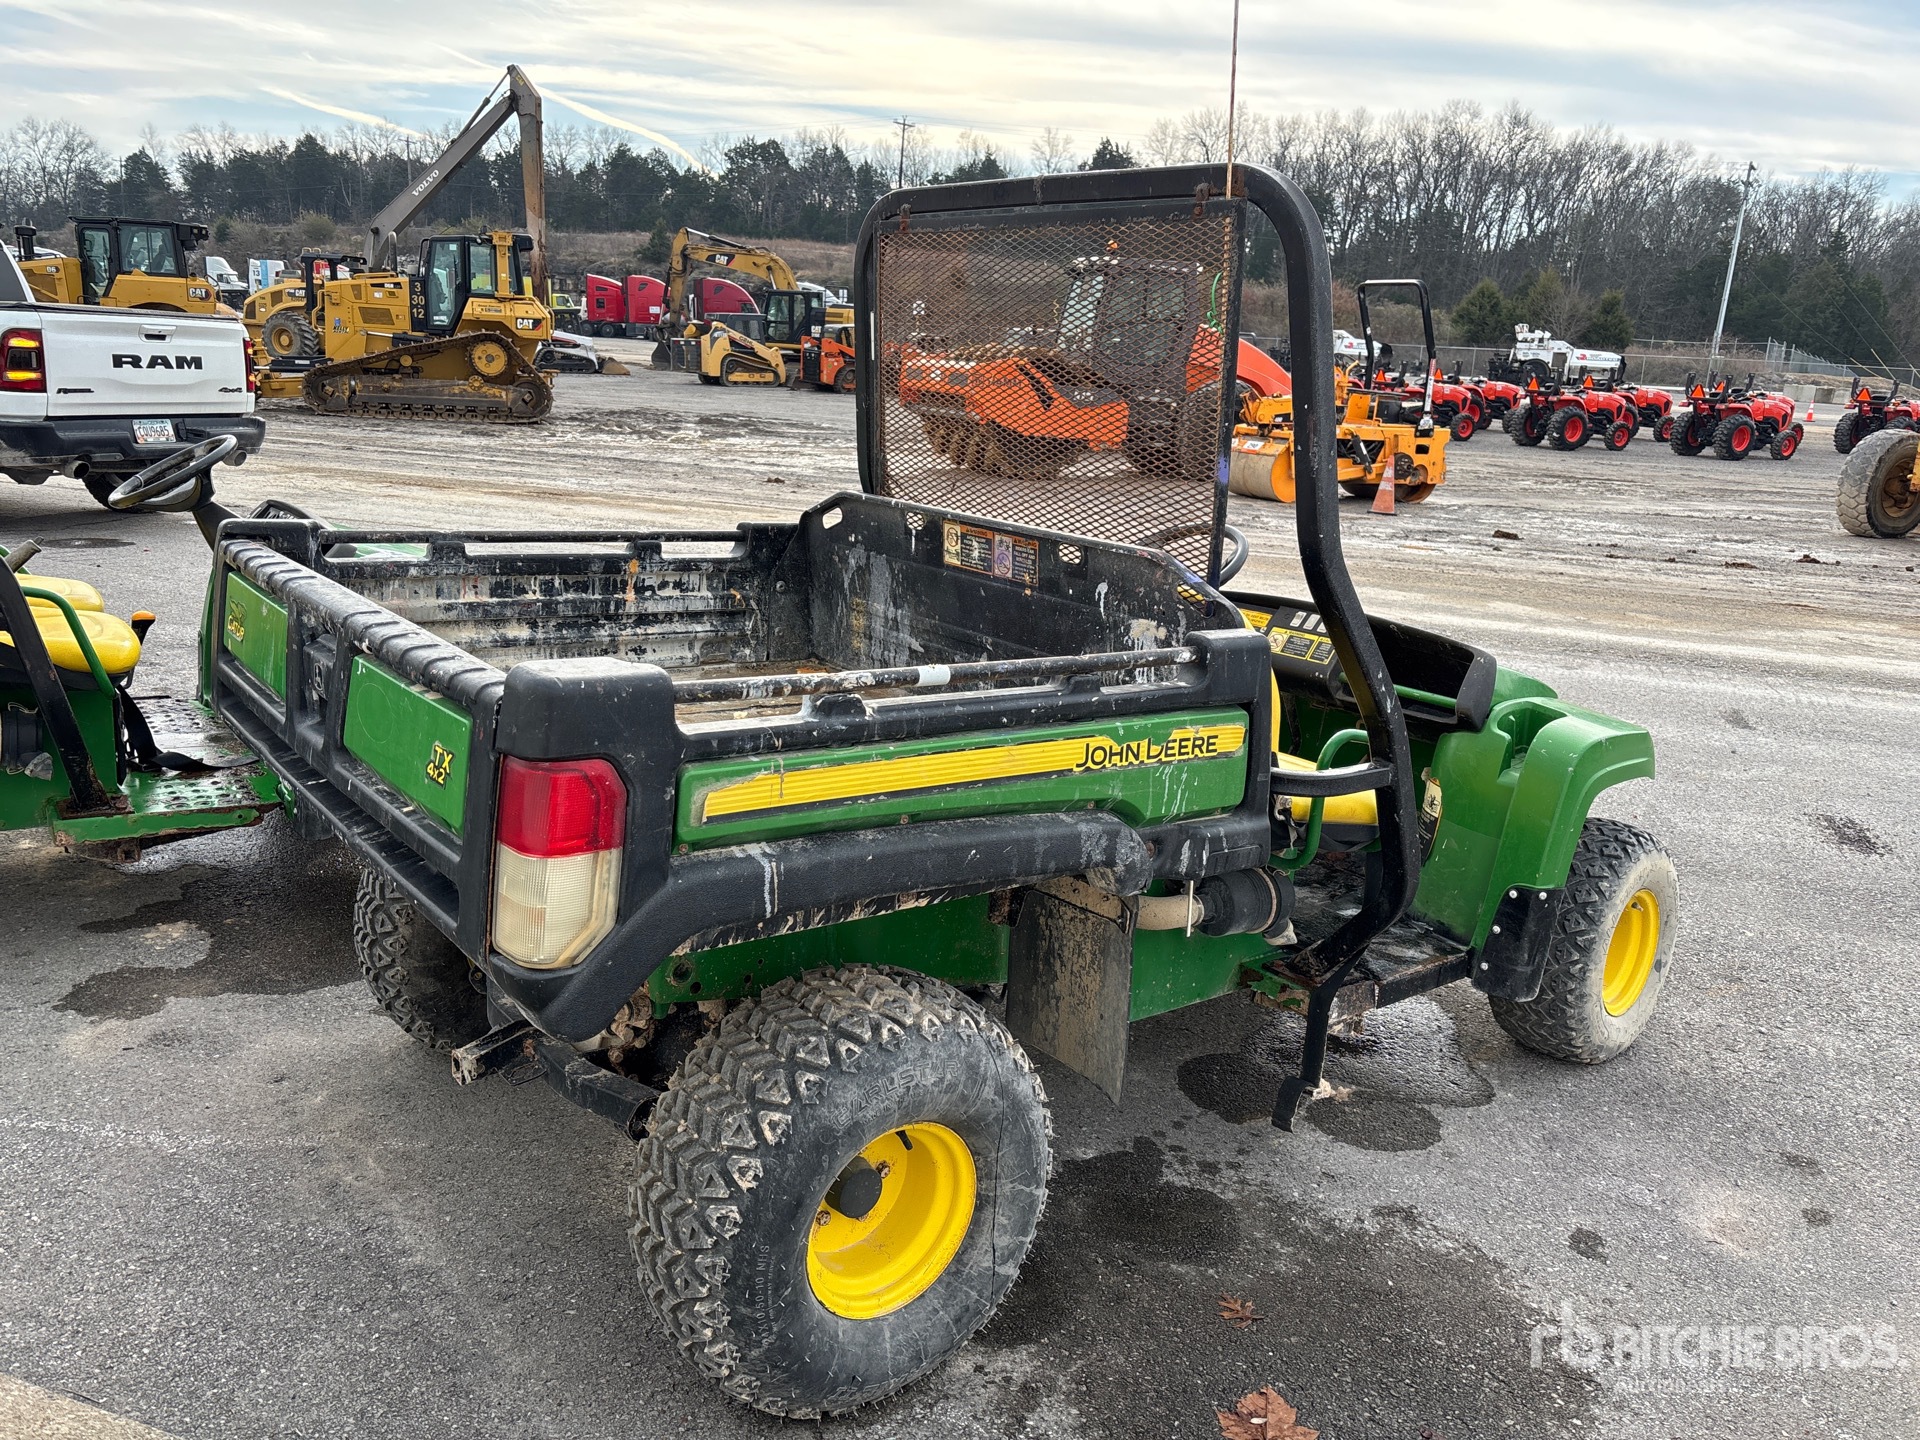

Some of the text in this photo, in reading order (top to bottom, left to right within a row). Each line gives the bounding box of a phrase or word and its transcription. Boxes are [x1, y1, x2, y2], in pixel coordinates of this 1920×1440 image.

[411, 169, 440, 197] VOLVO
[715, 254, 728, 265] CAT
[189, 288, 206, 298] CAT
[414, 282, 421, 291] 3
[411, 295, 425, 305] 30
[412, 308, 425, 318] 12
[516, 319, 533, 329] CAT
[811, 325, 822, 333] CAT
[112, 354, 203, 370] RAM
[227, 615, 245, 640] GATOR
[1076, 735, 1219, 768] JOHN DEERE
[434, 745, 453, 773] TX
[426, 762, 446, 784] 4x2
[756, 1245, 770, 1271] NHS
